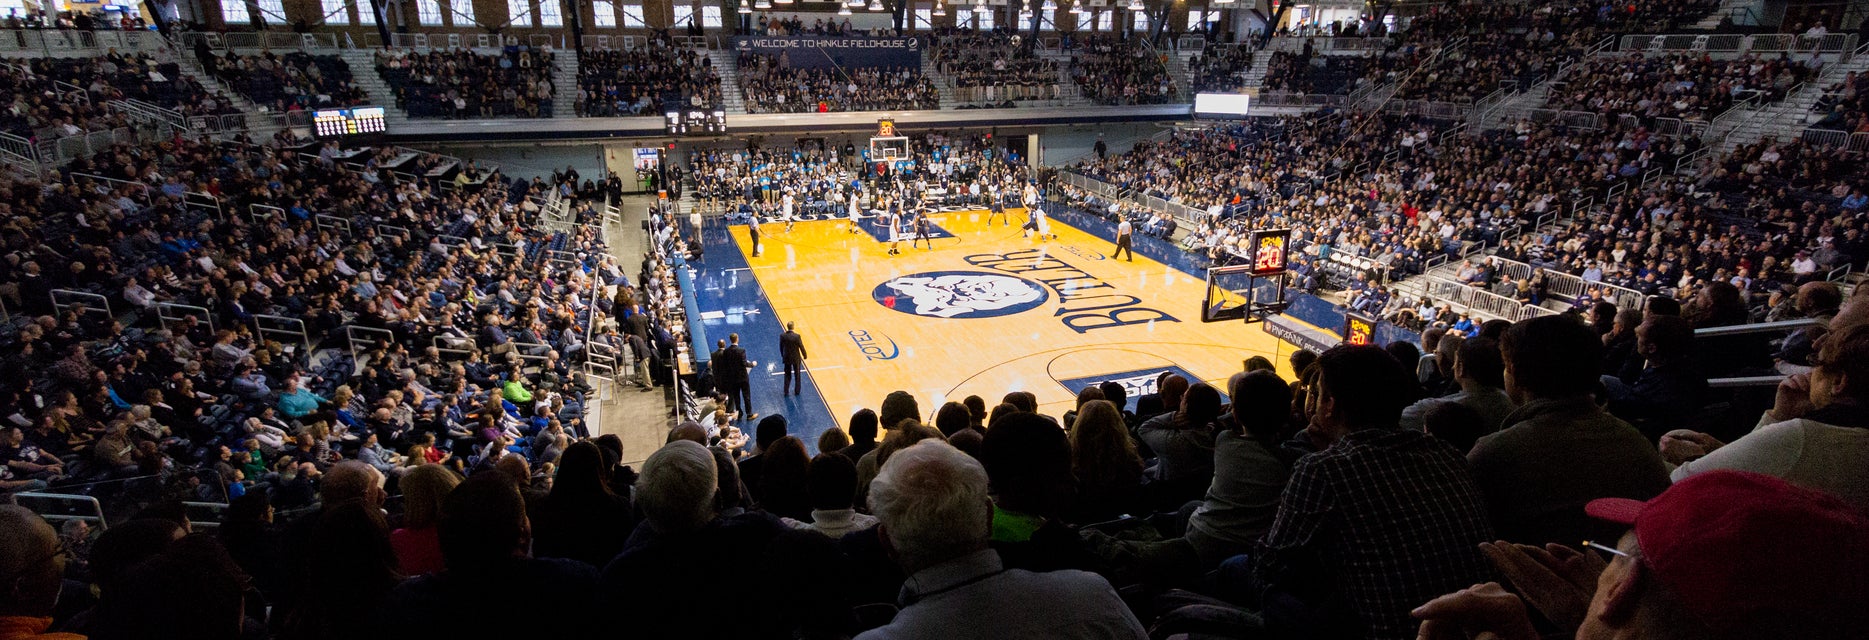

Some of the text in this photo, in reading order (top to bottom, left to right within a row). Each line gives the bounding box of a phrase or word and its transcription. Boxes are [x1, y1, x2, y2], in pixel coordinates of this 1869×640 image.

[752, 39, 906, 48] WELCOME TO HINKLE FIELDHOUSE
[881, 126, 892, 135] 20
[1259, 248, 1280, 269] 20
[962, 248, 1183, 335] BUTLER
[1351, 330, 1366, 345] 20
